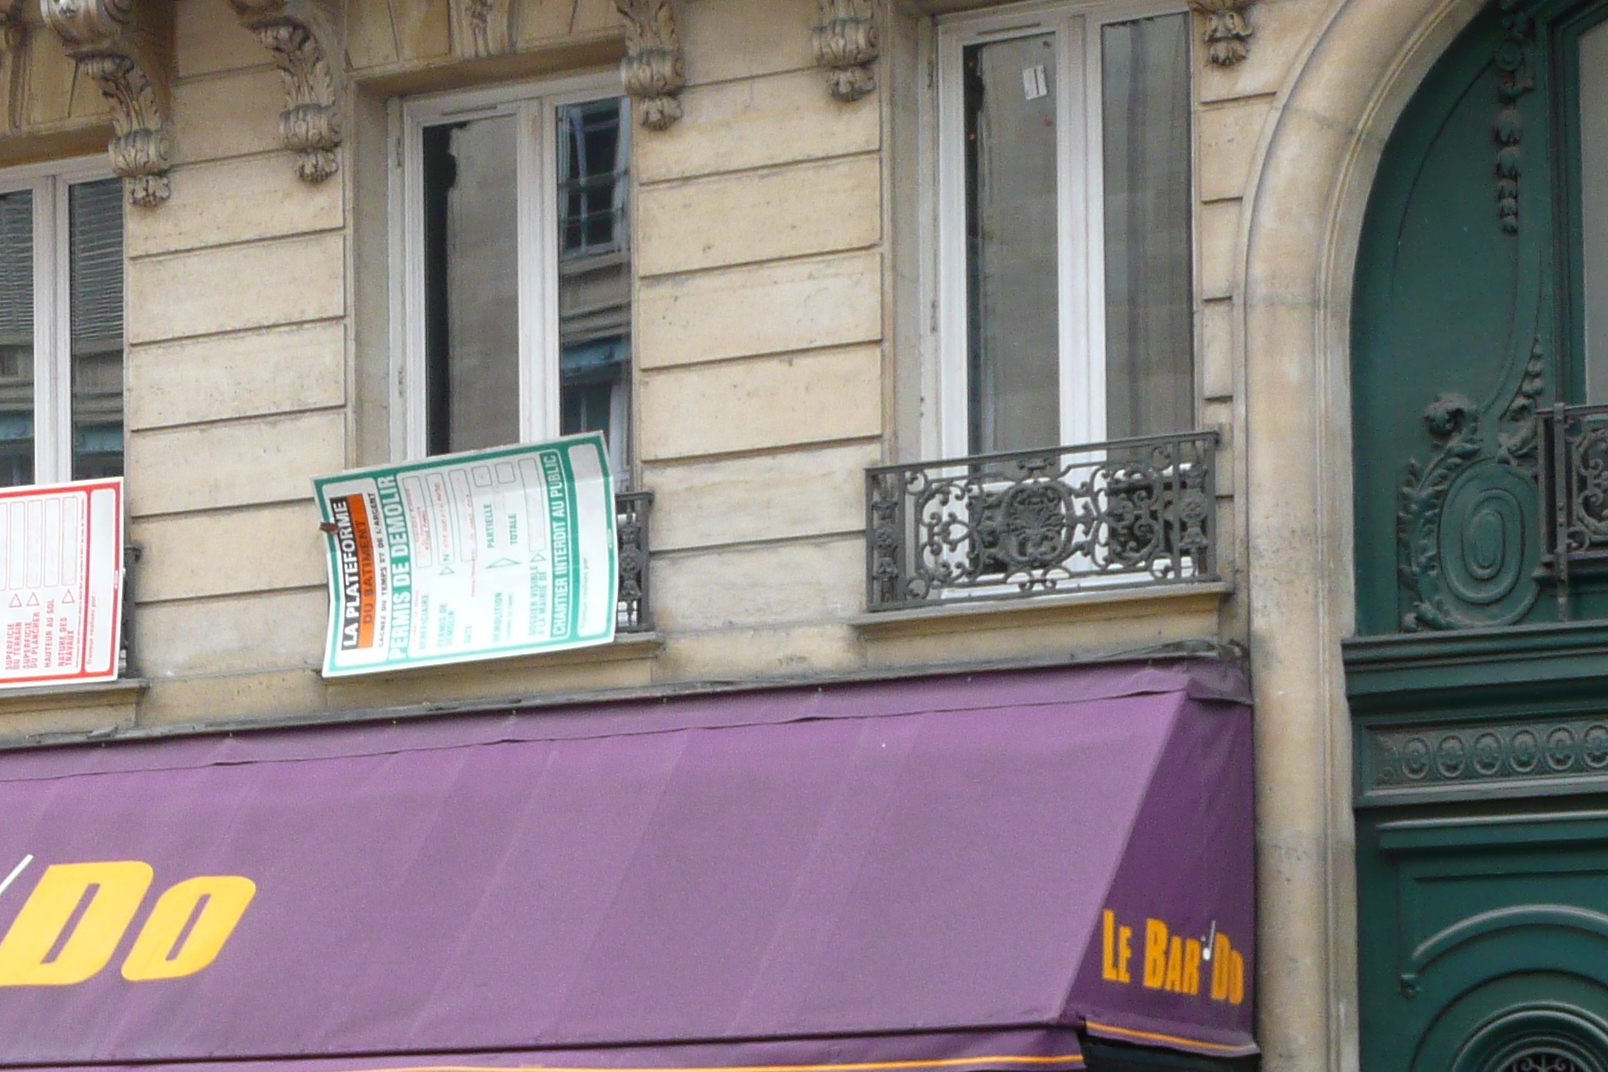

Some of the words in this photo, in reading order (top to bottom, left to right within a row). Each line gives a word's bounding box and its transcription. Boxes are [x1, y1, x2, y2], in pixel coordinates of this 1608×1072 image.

[544, 455, 563, 497] PUBLIC
[377, 475, 409, 557] DEMOLIR
[552, 501, 565, 517] AU
[483, 503, 494, 549] PARTIELLE
[508, 513, 518, 545] TOTALE
[377, 538, 384, 549] DE
[553, 521, 568, 575] INTERDIT
[333, 501, 360, 619] PLATEFORME
[392, 561, 410, 587] DE
[539, 570, 547, 581] DE
[380, 567, 388, 597] TEMPS
[46, 599, 54, 614] SOL
[363, 603, 373, 624] DU
[380, 600, 387, 611] DU
[552, 579, 568, 635] CHANTIER
[13, 621, 22, 656] TERRAIN
[30, 611, 40, 655] PLANCHER
[46, 617, 54, 628] AU
[59, 617, 68, 632] DES
[343, 623, 359, 647] LA
[389, 591, 411, 659] PERMIS
[5, 623, 14, 671] SUPERFICIE
[22, 622, 32, 669] SUPERFICIE
[44, 630, 53, 668] HAUTEUR
[57, 635, 67, 667] NATURE
[65, 629, 74, 666] TRAVAUX
[12, 658, 20, 670] DU
[30, 657, 38, 669] DU
